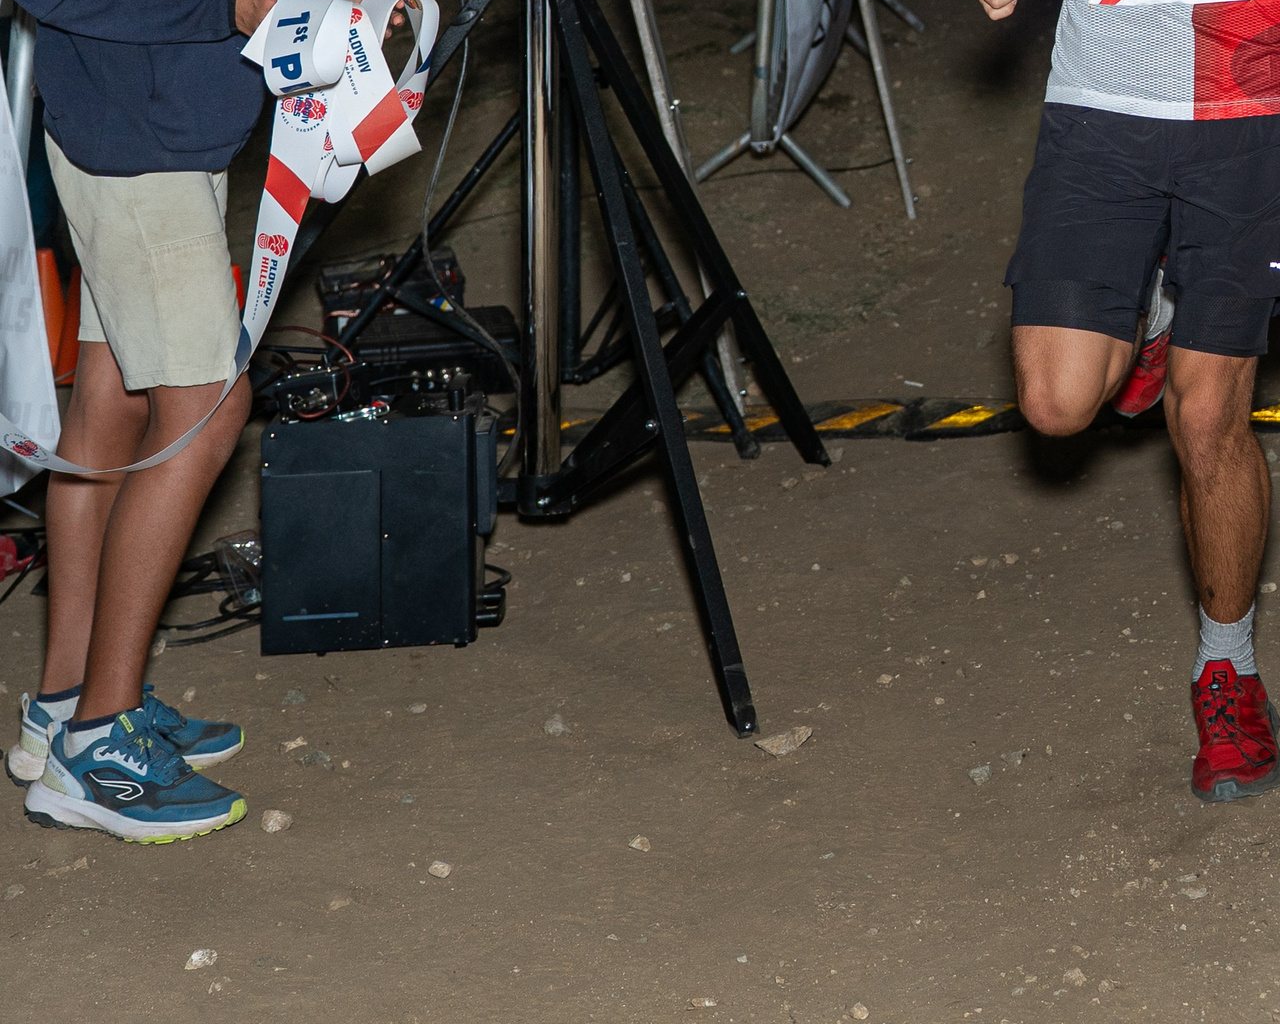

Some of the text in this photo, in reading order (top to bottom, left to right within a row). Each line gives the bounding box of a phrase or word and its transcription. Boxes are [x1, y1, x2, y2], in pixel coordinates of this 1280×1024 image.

[277, 10, 311, 44] 1st
[349, 28, 372, 73] PLOVDIV
[293, 96, 304, 117] HILLS
[301, 92, 314, 124] PLOVDIV
[259, 257, 269, 288] HILLS
[263, 259, 278, 307] PLOVDIV
